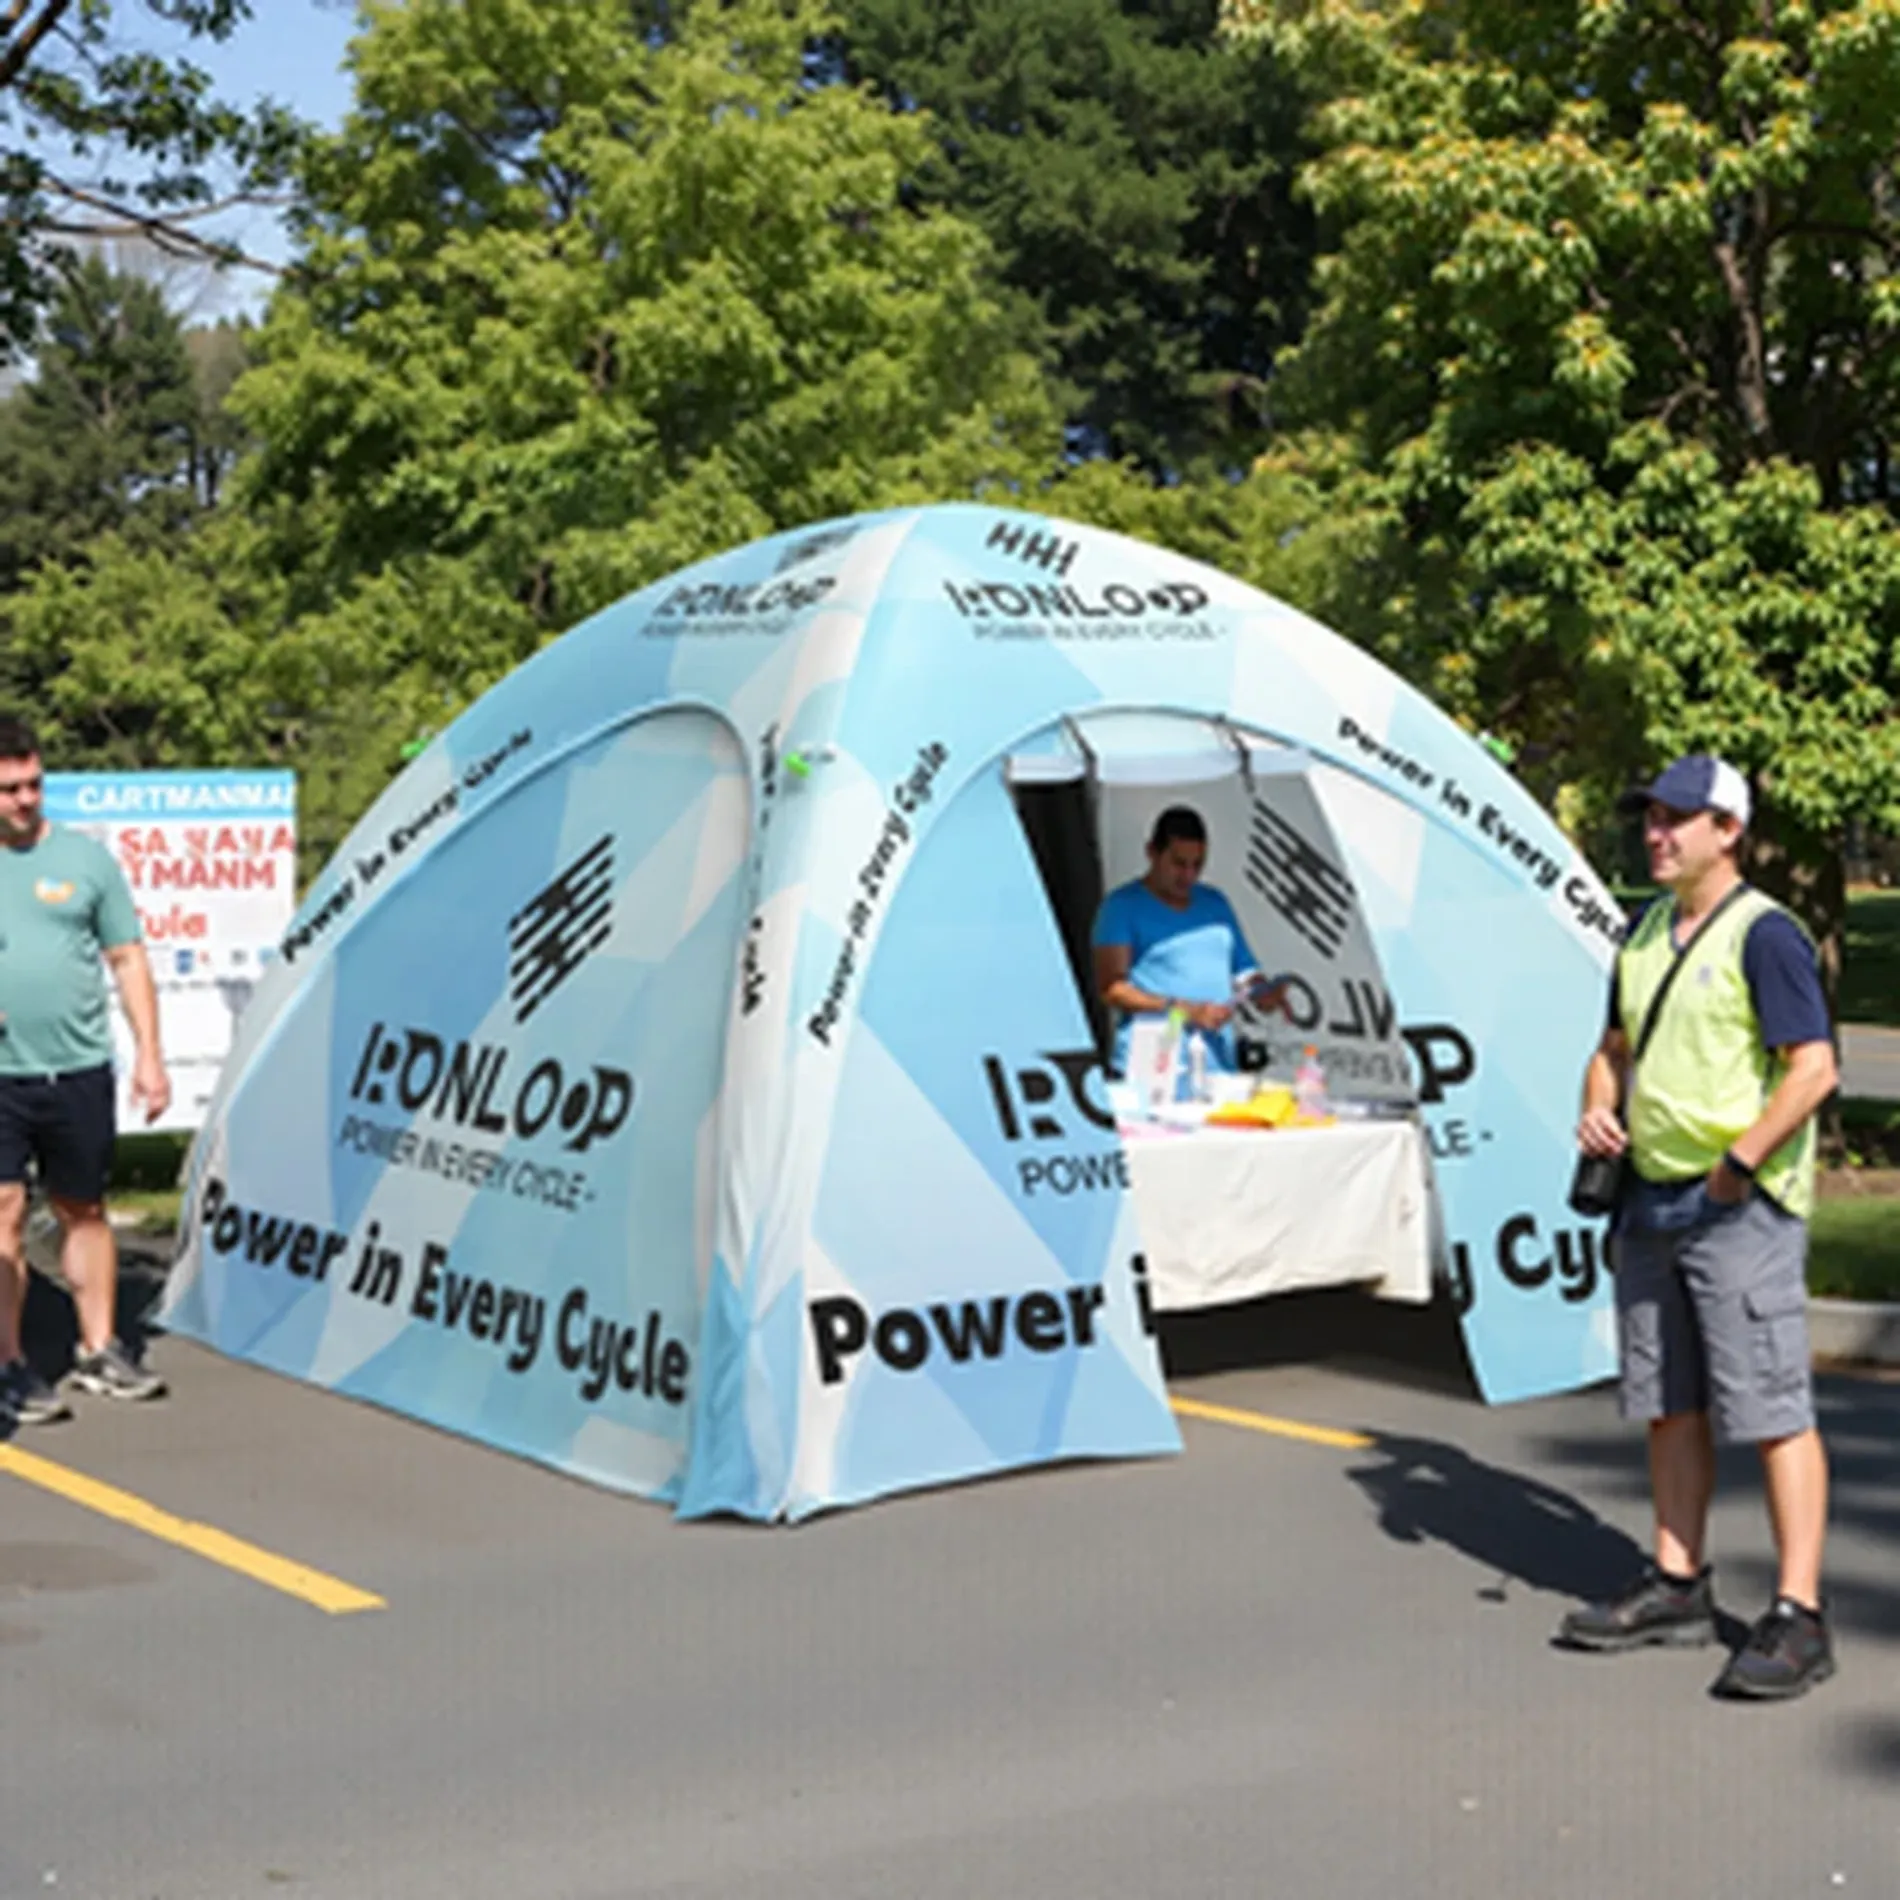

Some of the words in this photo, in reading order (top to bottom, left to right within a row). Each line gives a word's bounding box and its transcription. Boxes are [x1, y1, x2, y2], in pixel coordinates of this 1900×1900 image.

[1338, 716, 1435, 788] Power
[1441, 777, 1472, 817] in
[1478, 802, 1562, 890] Every
[1017, 1149, 1132, 1197] POWE
[202, 1177, 347, 1282] Power
[349, 1220, 402, 1306] in
[410, 1241, 546, 1374] Every
[555, 1287, 690, 1405] Cycle
[809, 1282, 1106, 1386] Power
